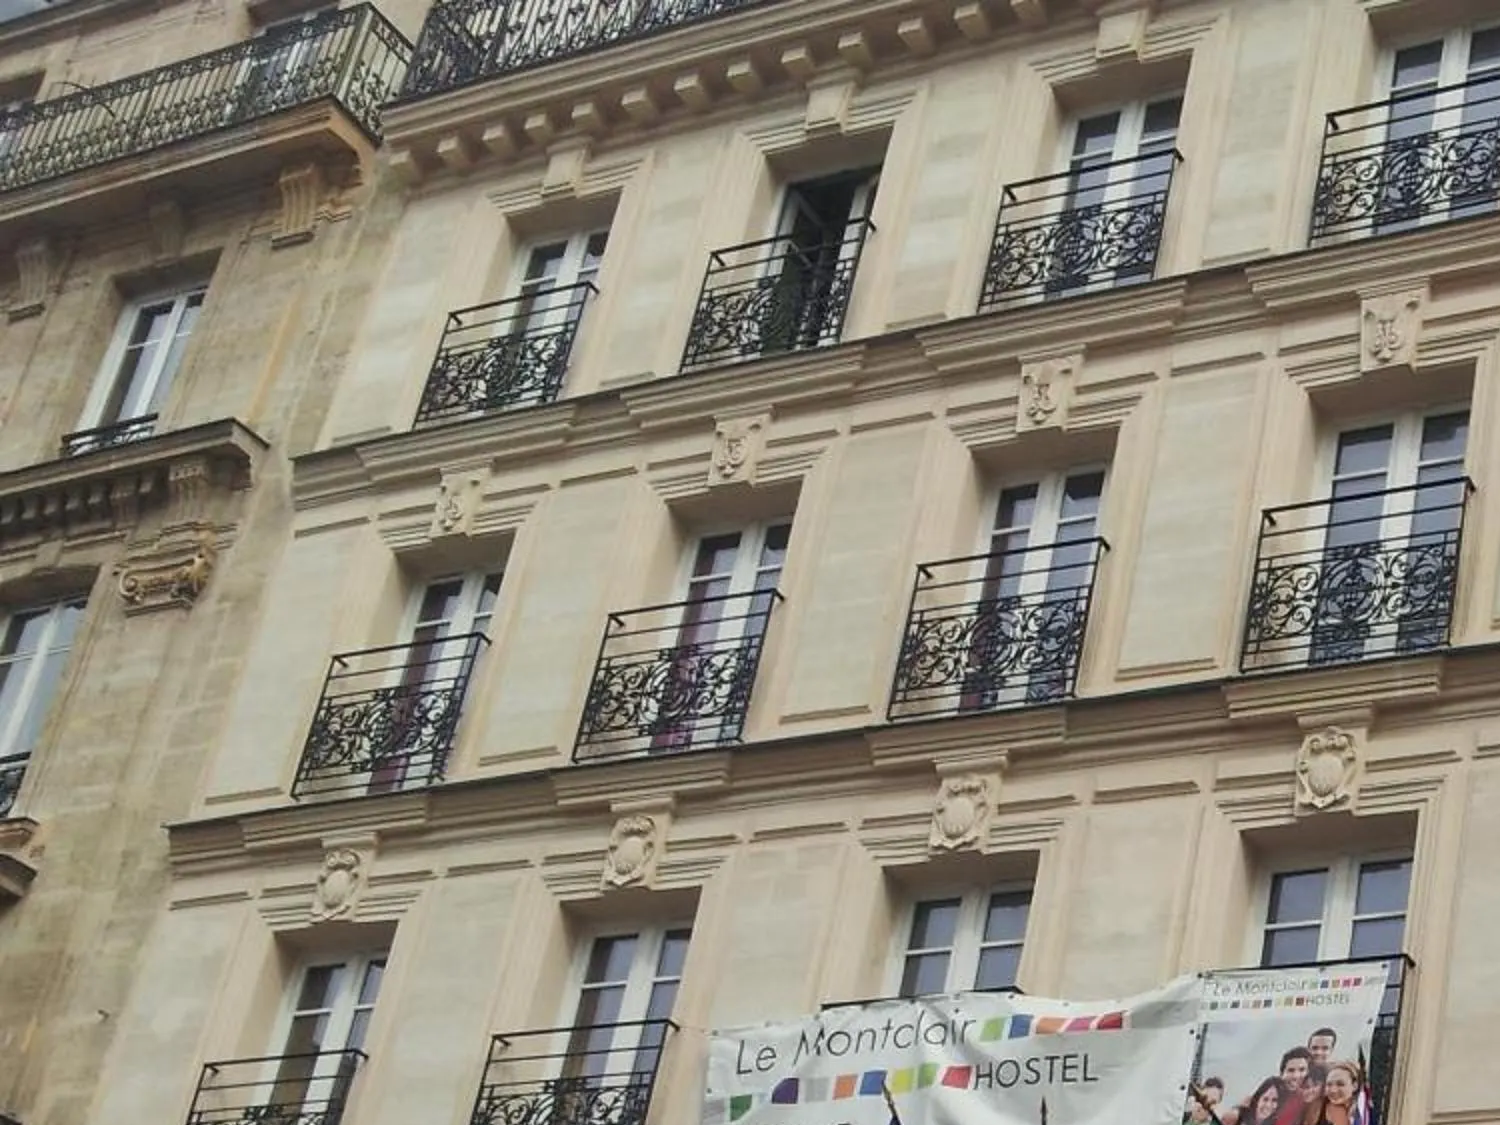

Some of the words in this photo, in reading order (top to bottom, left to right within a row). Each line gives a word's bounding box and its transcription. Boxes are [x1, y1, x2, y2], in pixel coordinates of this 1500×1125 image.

[1306, 991, 1350, 1006] HOSTEL
[736, 1039, 777, 1075] Le
[792, 1009, 977, 1067] Montclair
[973, 1053, 1099, 1090] HOSTEL
